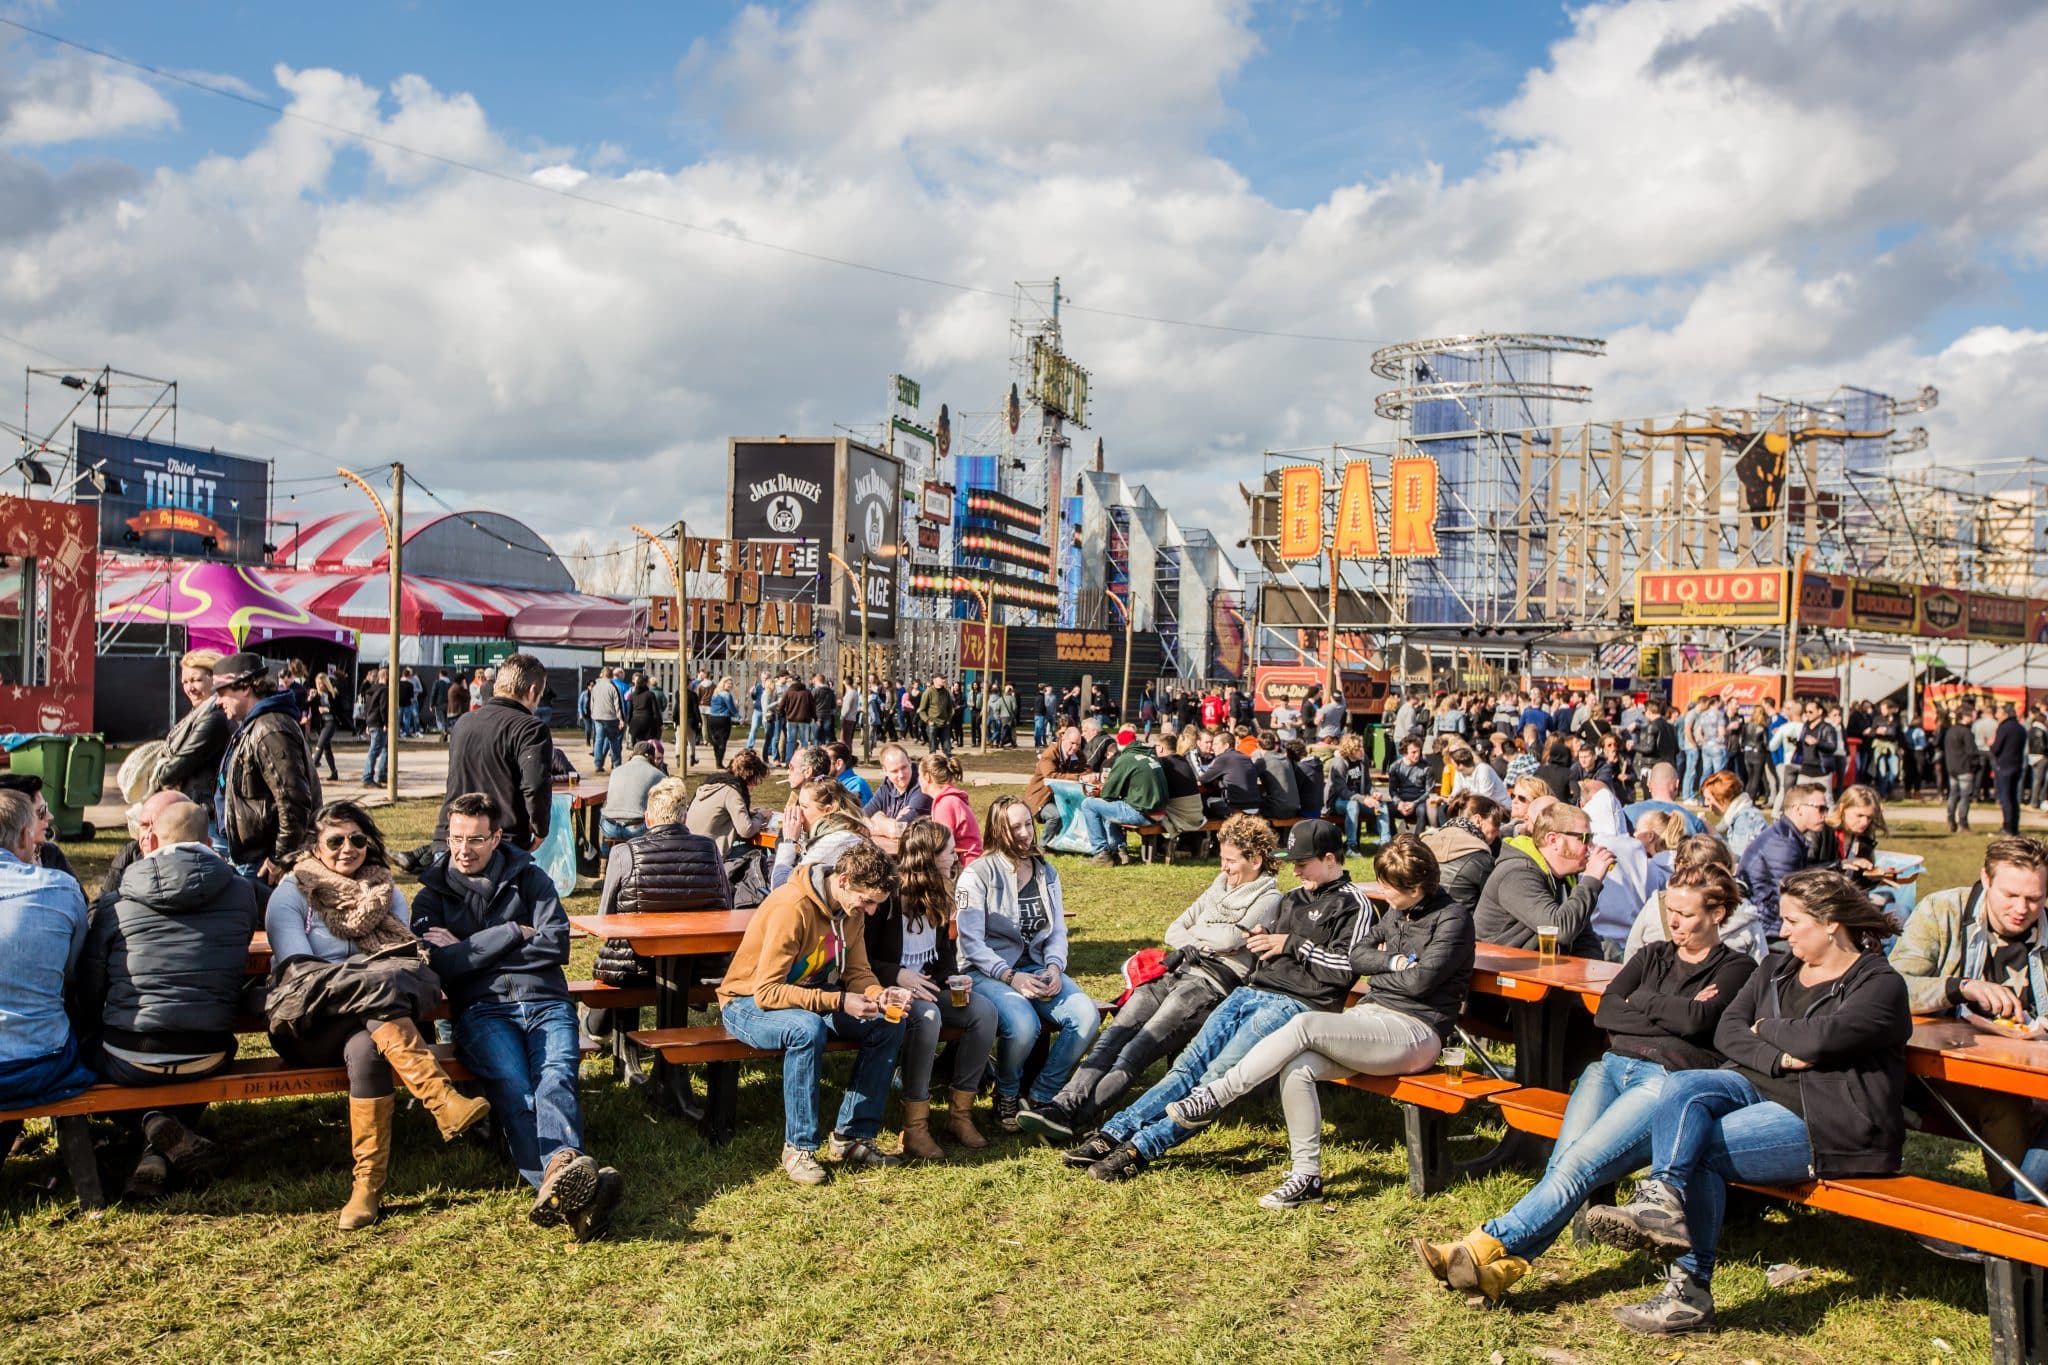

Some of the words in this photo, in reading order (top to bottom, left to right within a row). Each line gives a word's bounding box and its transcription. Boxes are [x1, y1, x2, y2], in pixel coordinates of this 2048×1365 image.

[167, 458, 196, 476] Toilet
[143, 469, 217, 518] TOILET
[749, 478, 778, 502] JACK
[1278, 454, 1441, 562] BAR
[685, 537, 723, 573] WE
[731, 538, 797, 578] LIVE
[724, 569, 760, 604] TO
[851, 575, 890, 608] SAGE
[1644, 577, 1776, 601] LIQUOR
[652, 595, 813, 638] ENTERTAIN
[1720, 683, 1757, 702] Cool
[1018, 902, 1043, 918] HE
[244, 1081, 263, 1094] DE
[268, 1079, 311, 1092] HAAS
